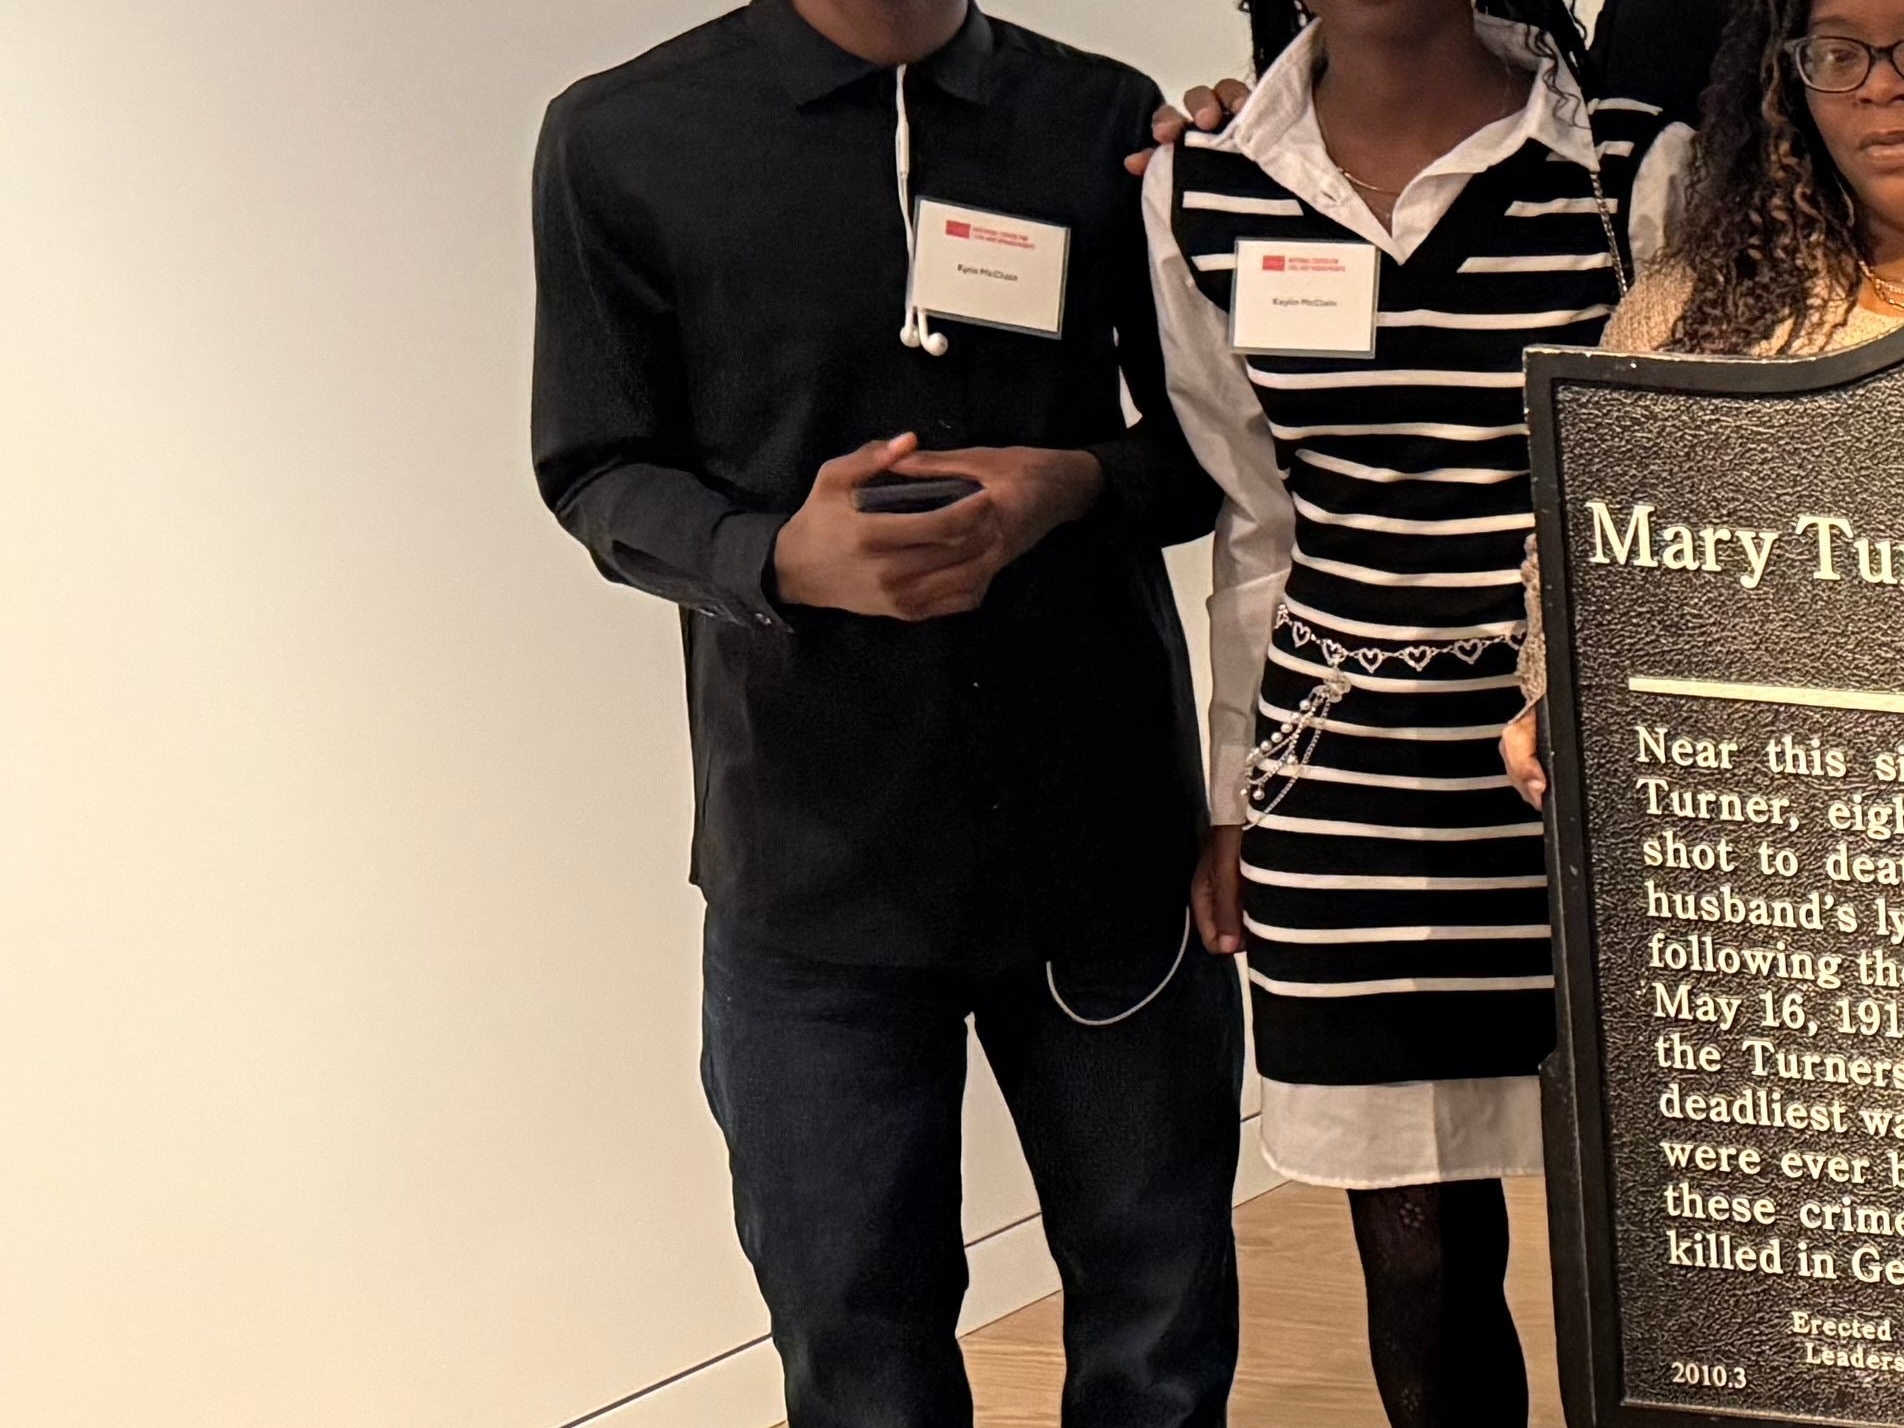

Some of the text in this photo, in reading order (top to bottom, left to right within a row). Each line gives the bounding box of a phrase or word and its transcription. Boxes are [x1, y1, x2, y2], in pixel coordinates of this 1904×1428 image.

[1585, 502, 1780, 589] Mary
[1635, 725, 1740, 770] Near
[1765, 736, 1848, 779] this
[1636, 776, 1800, 834] Turner,
[1642, 830, 1737, 873] shot
[1757, 843, 1799, 878] to
[1644, 879, 1859, 933] husband's
[1648, 930, 1843, 991] following
[1651, 981, 1744, 1032] May
[1758, 990, 1819, 1039] 16,
[1654, 1032, 1722, 1072] the
[1657, 1081, 1849, 1133] deadliest
[1661, 1140, 1762, 1174] were
[1779, 1150, 1872, 1185] ever
[1663, 1181, 1777, 1225] these
[1666, 1229, 1784, 1274] killed
[1795, 1240, 1838, 1279] in
[1792, 1310, 1892, 1341] Erected
[1671, 1360, 1748, 1390] 2010.3
